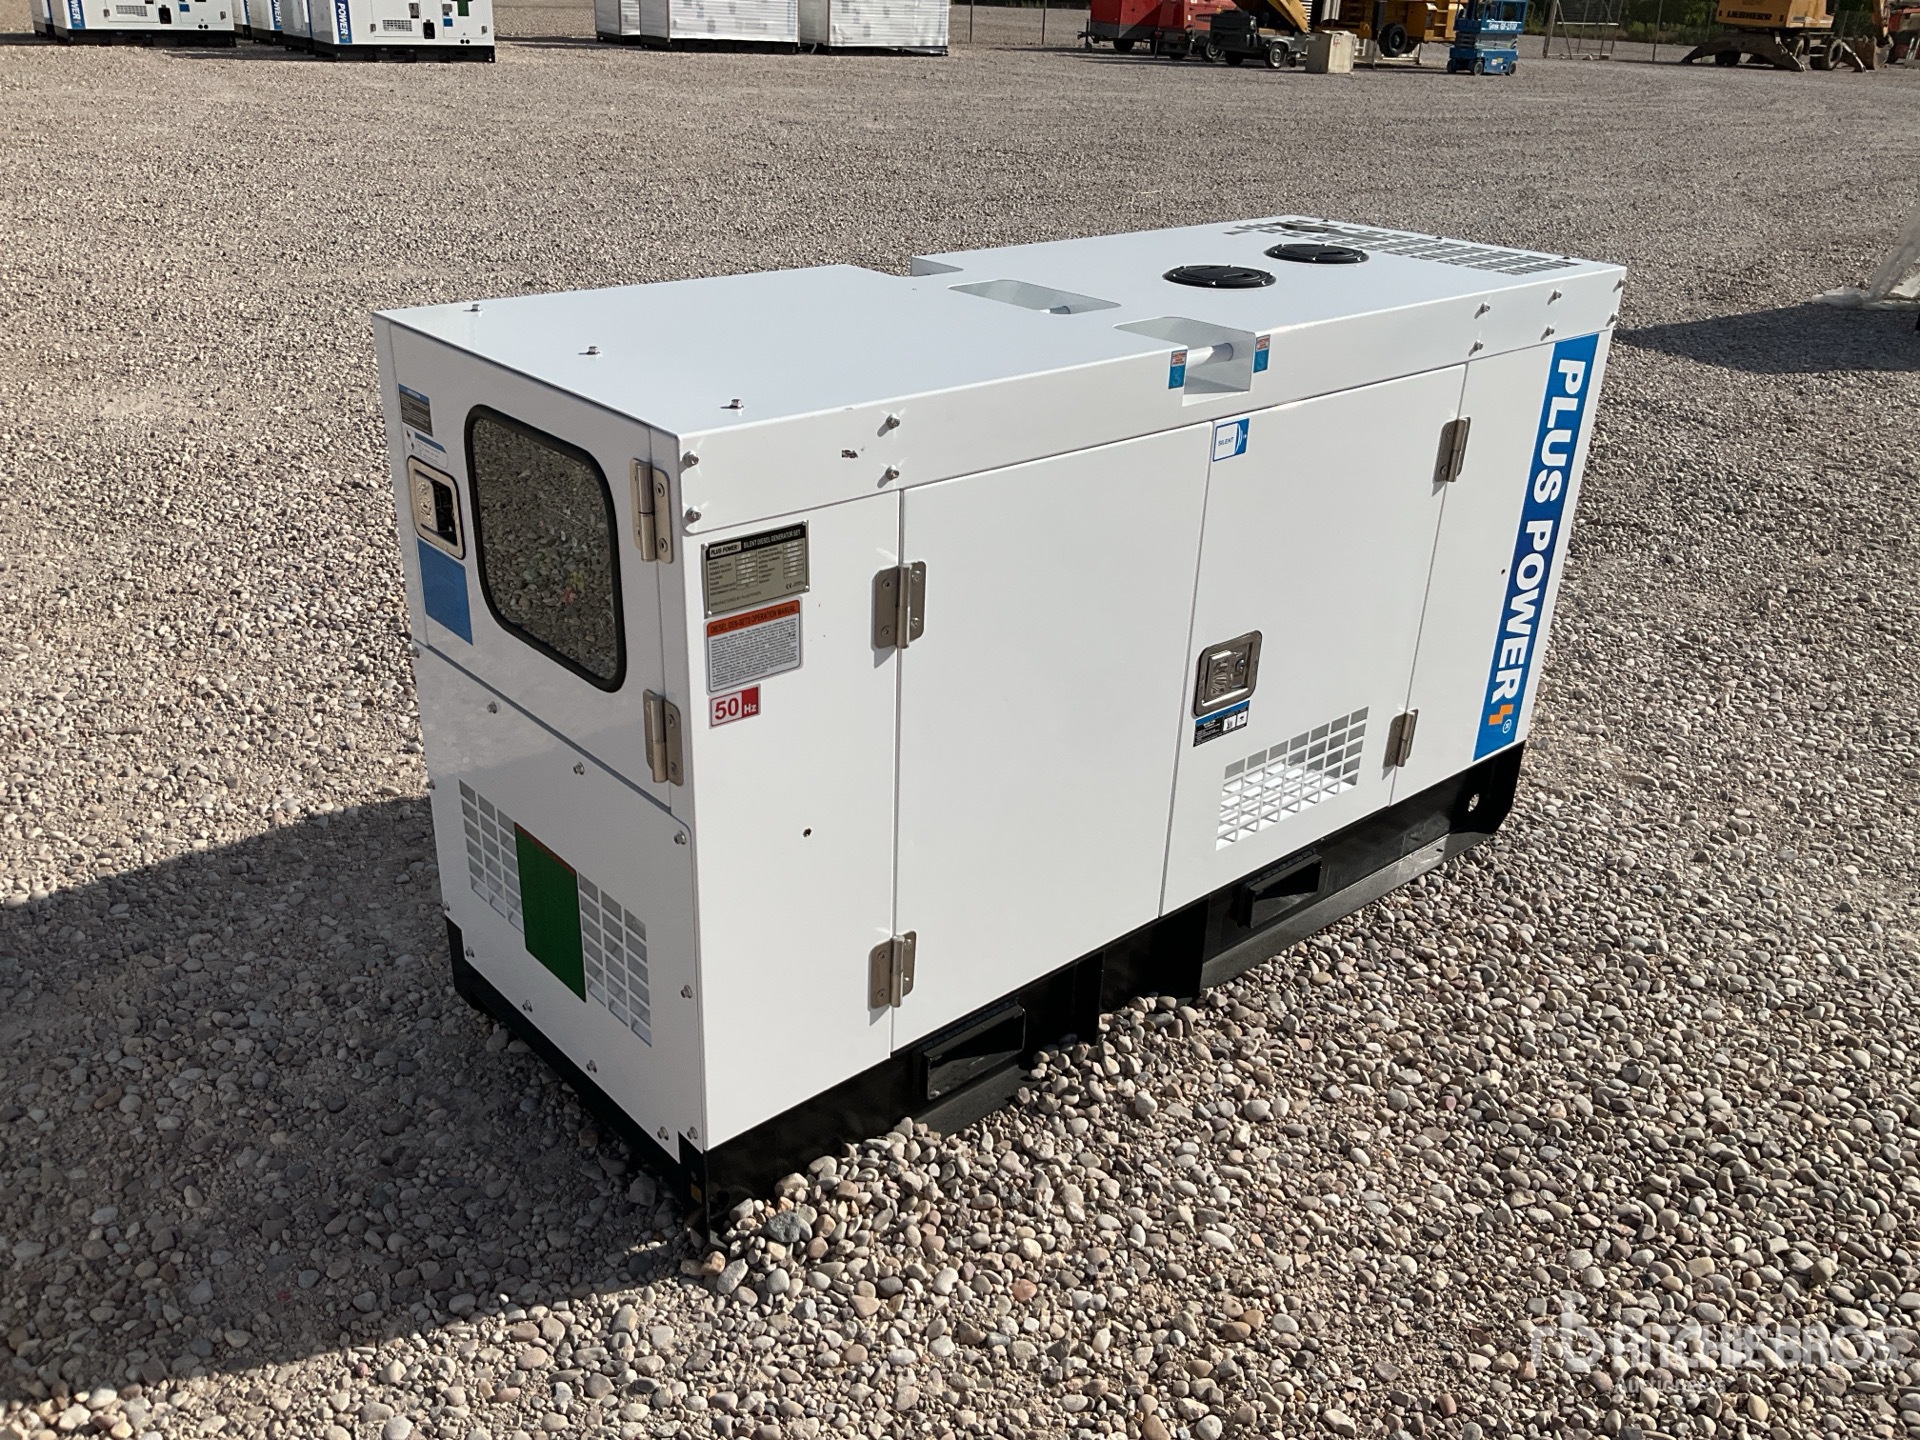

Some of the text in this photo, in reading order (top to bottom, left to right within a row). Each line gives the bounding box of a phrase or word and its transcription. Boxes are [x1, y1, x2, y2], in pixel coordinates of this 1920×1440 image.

[337, 3, 348, 35] POWER
[1727, 10, 1772, 20] LIEBHERR
[1218, 437, 1234, 446] SILENT
[743, 539, 757, 548] SILENT
[757, 537, 770, 546] DIESEL
[771, 531, 792, 543] GENERATOR
[1491, 359, 1586, 704] PLUS POWER
[710, 544, 738, 555] PLUS POWER
[711, 623, 727, 633] DIESEL
[750, 608, 776, 624] OPERATION
[777, 604, 795, 616] MANUAL
[715, 697, 757, 720] 50 Hz
